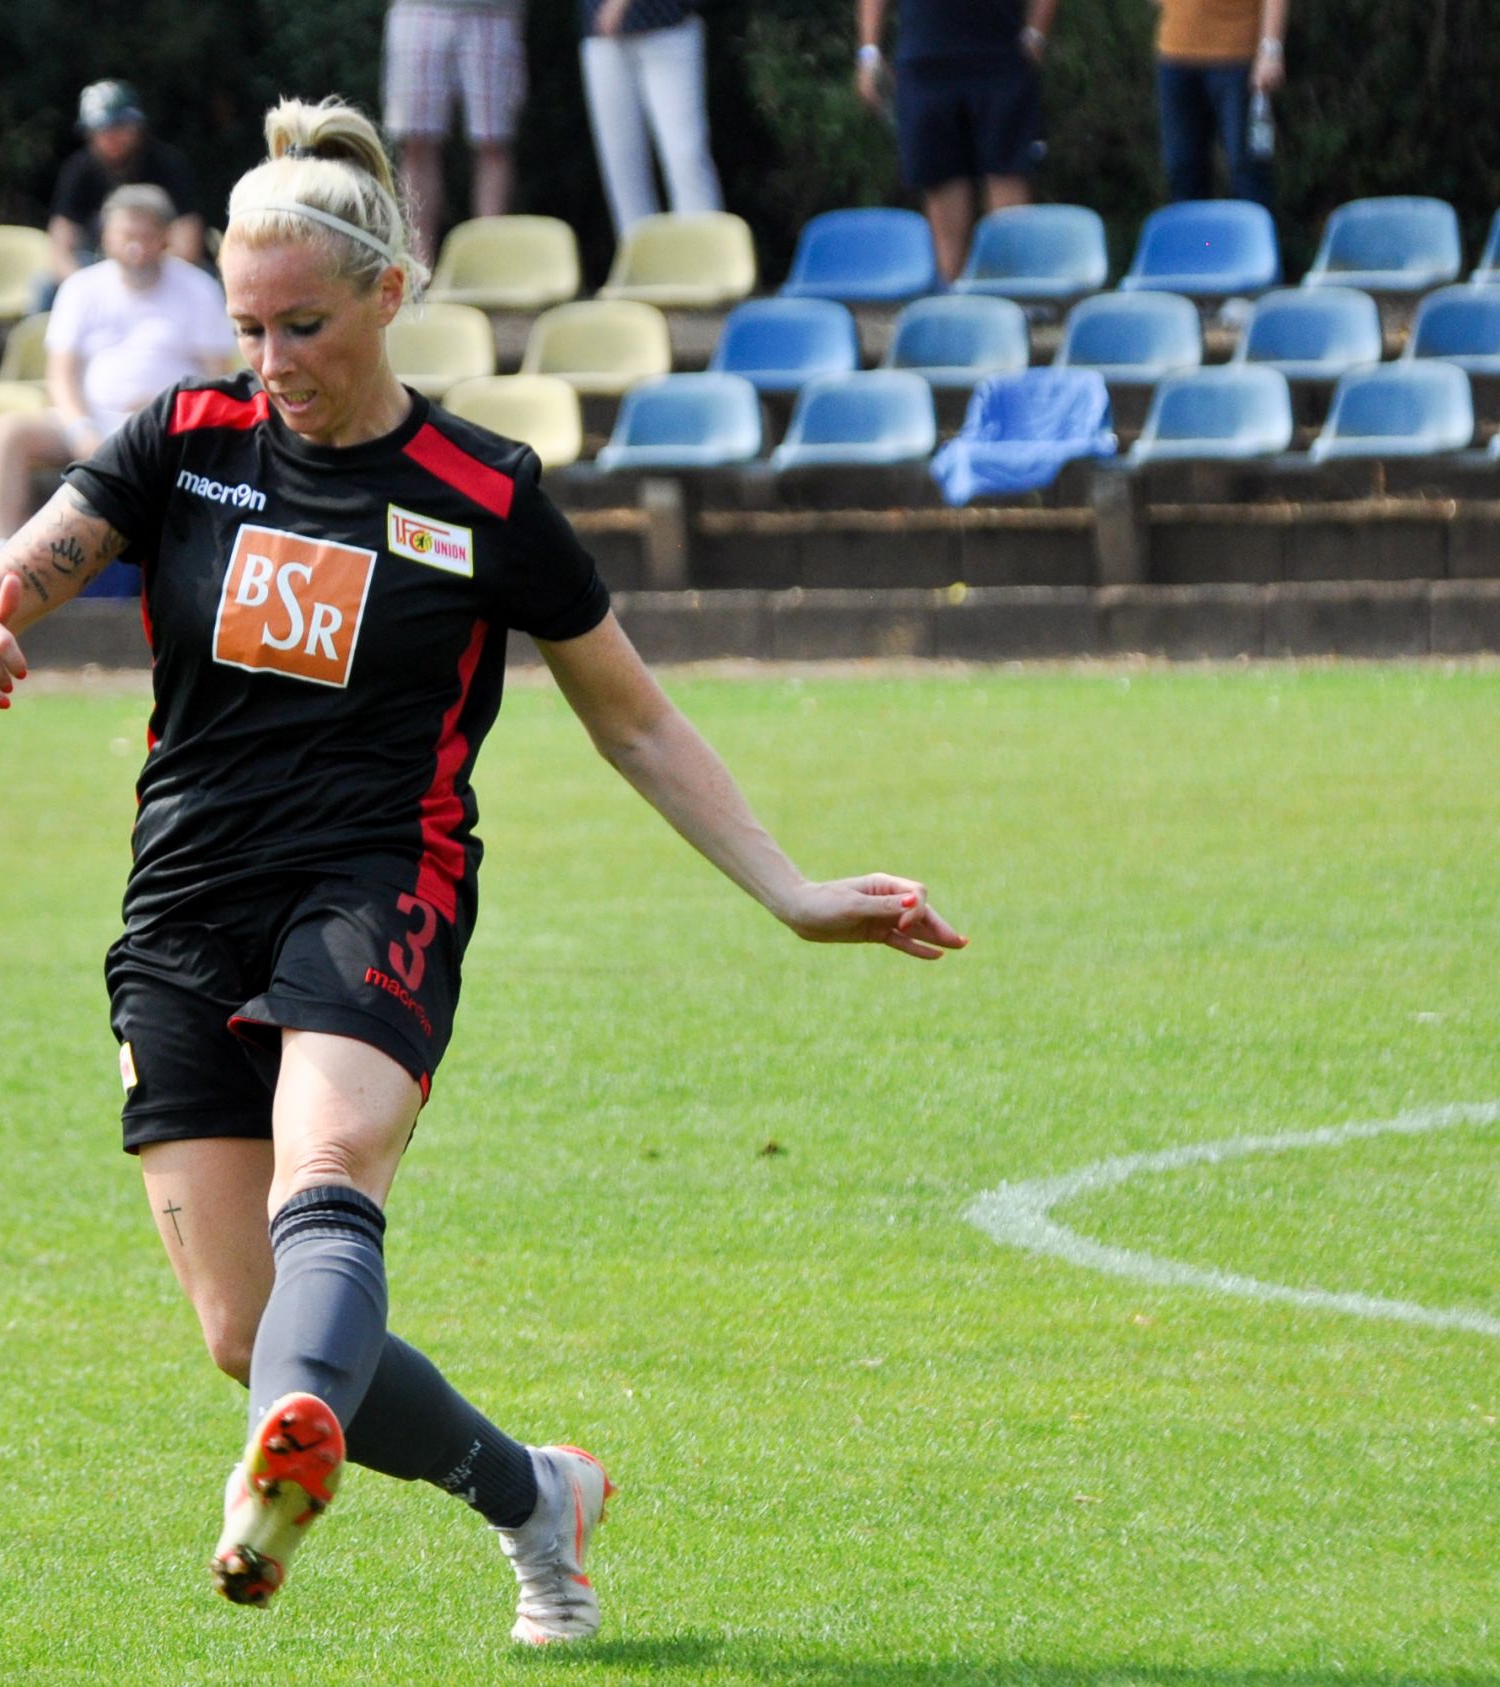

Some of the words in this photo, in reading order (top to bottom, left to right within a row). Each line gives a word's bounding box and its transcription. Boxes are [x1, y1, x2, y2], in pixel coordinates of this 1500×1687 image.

[434, 539, 467, 561] UNION
[234, 552, 344, 662] BSR
[387, 891, 438, 992] 3
